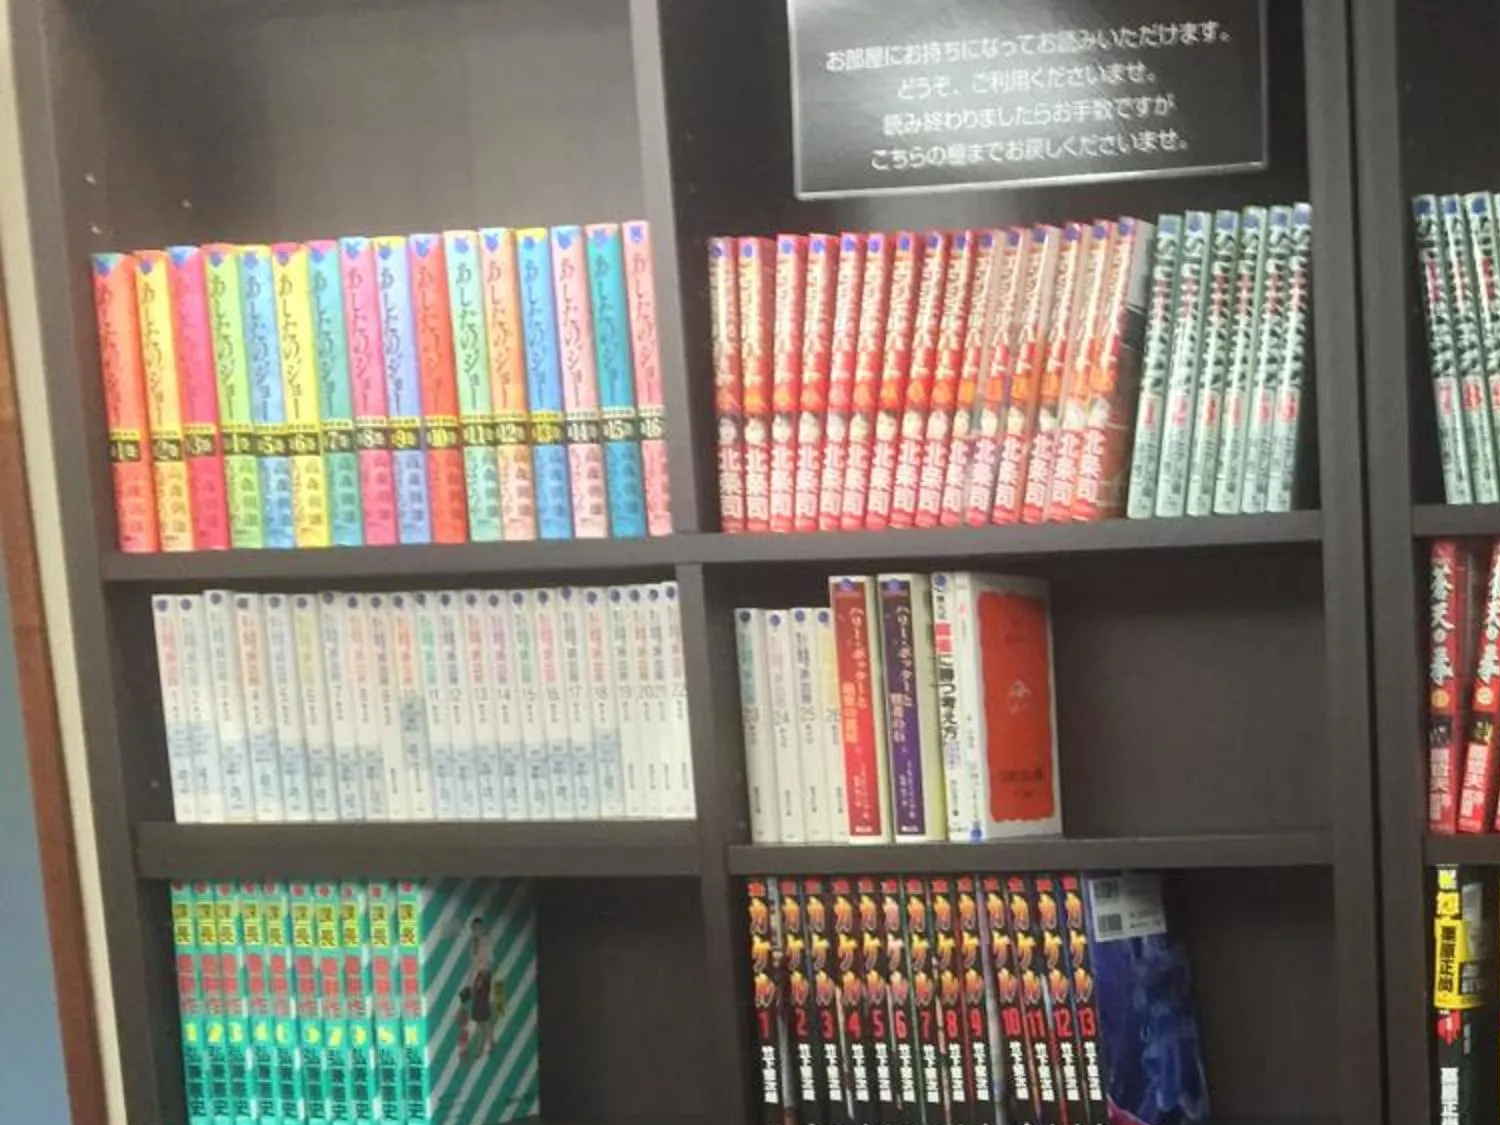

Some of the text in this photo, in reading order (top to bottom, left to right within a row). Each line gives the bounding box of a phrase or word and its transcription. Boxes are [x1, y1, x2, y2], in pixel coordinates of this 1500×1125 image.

[280, 273, 302, 419] あしたのジョー
[457, 262, 480, 410] あしたのジョー
[488, 260, 512, 409] あしたのジョー
[561, 257, 582, 407] あしたのジョー
[750, 896, 775, 1008] カケル
[783, 895, 809, 1006] カケル
[807, 895, 835, 1006] カケル
[834, 895, 862, 1006] カケル
[934, 894, 960, 1006] カケル
[959, 893, 985, 1005] カケル
[759, 1011, 769, 1040] 1
[795, 1009, 808, 1036] 2
[821, 1010, 833, 1038] 3
[847, 1010, 861, 1038] 4
[872, 1010, 885, 1038] 5
[895, 1009, 908, 1038] 6
[921, 1009, 930, 1038] 7
[945, 1009, 958, 1039] 8
[969, 1008, 982, 1036] 9
[1004, 1008, 1021, 1036] 10
[1028, 1008, 1045, 1038] 11
[1055, 1008, 1073, 1036] 12
[1079, 1007, 1096, 1036] 13
